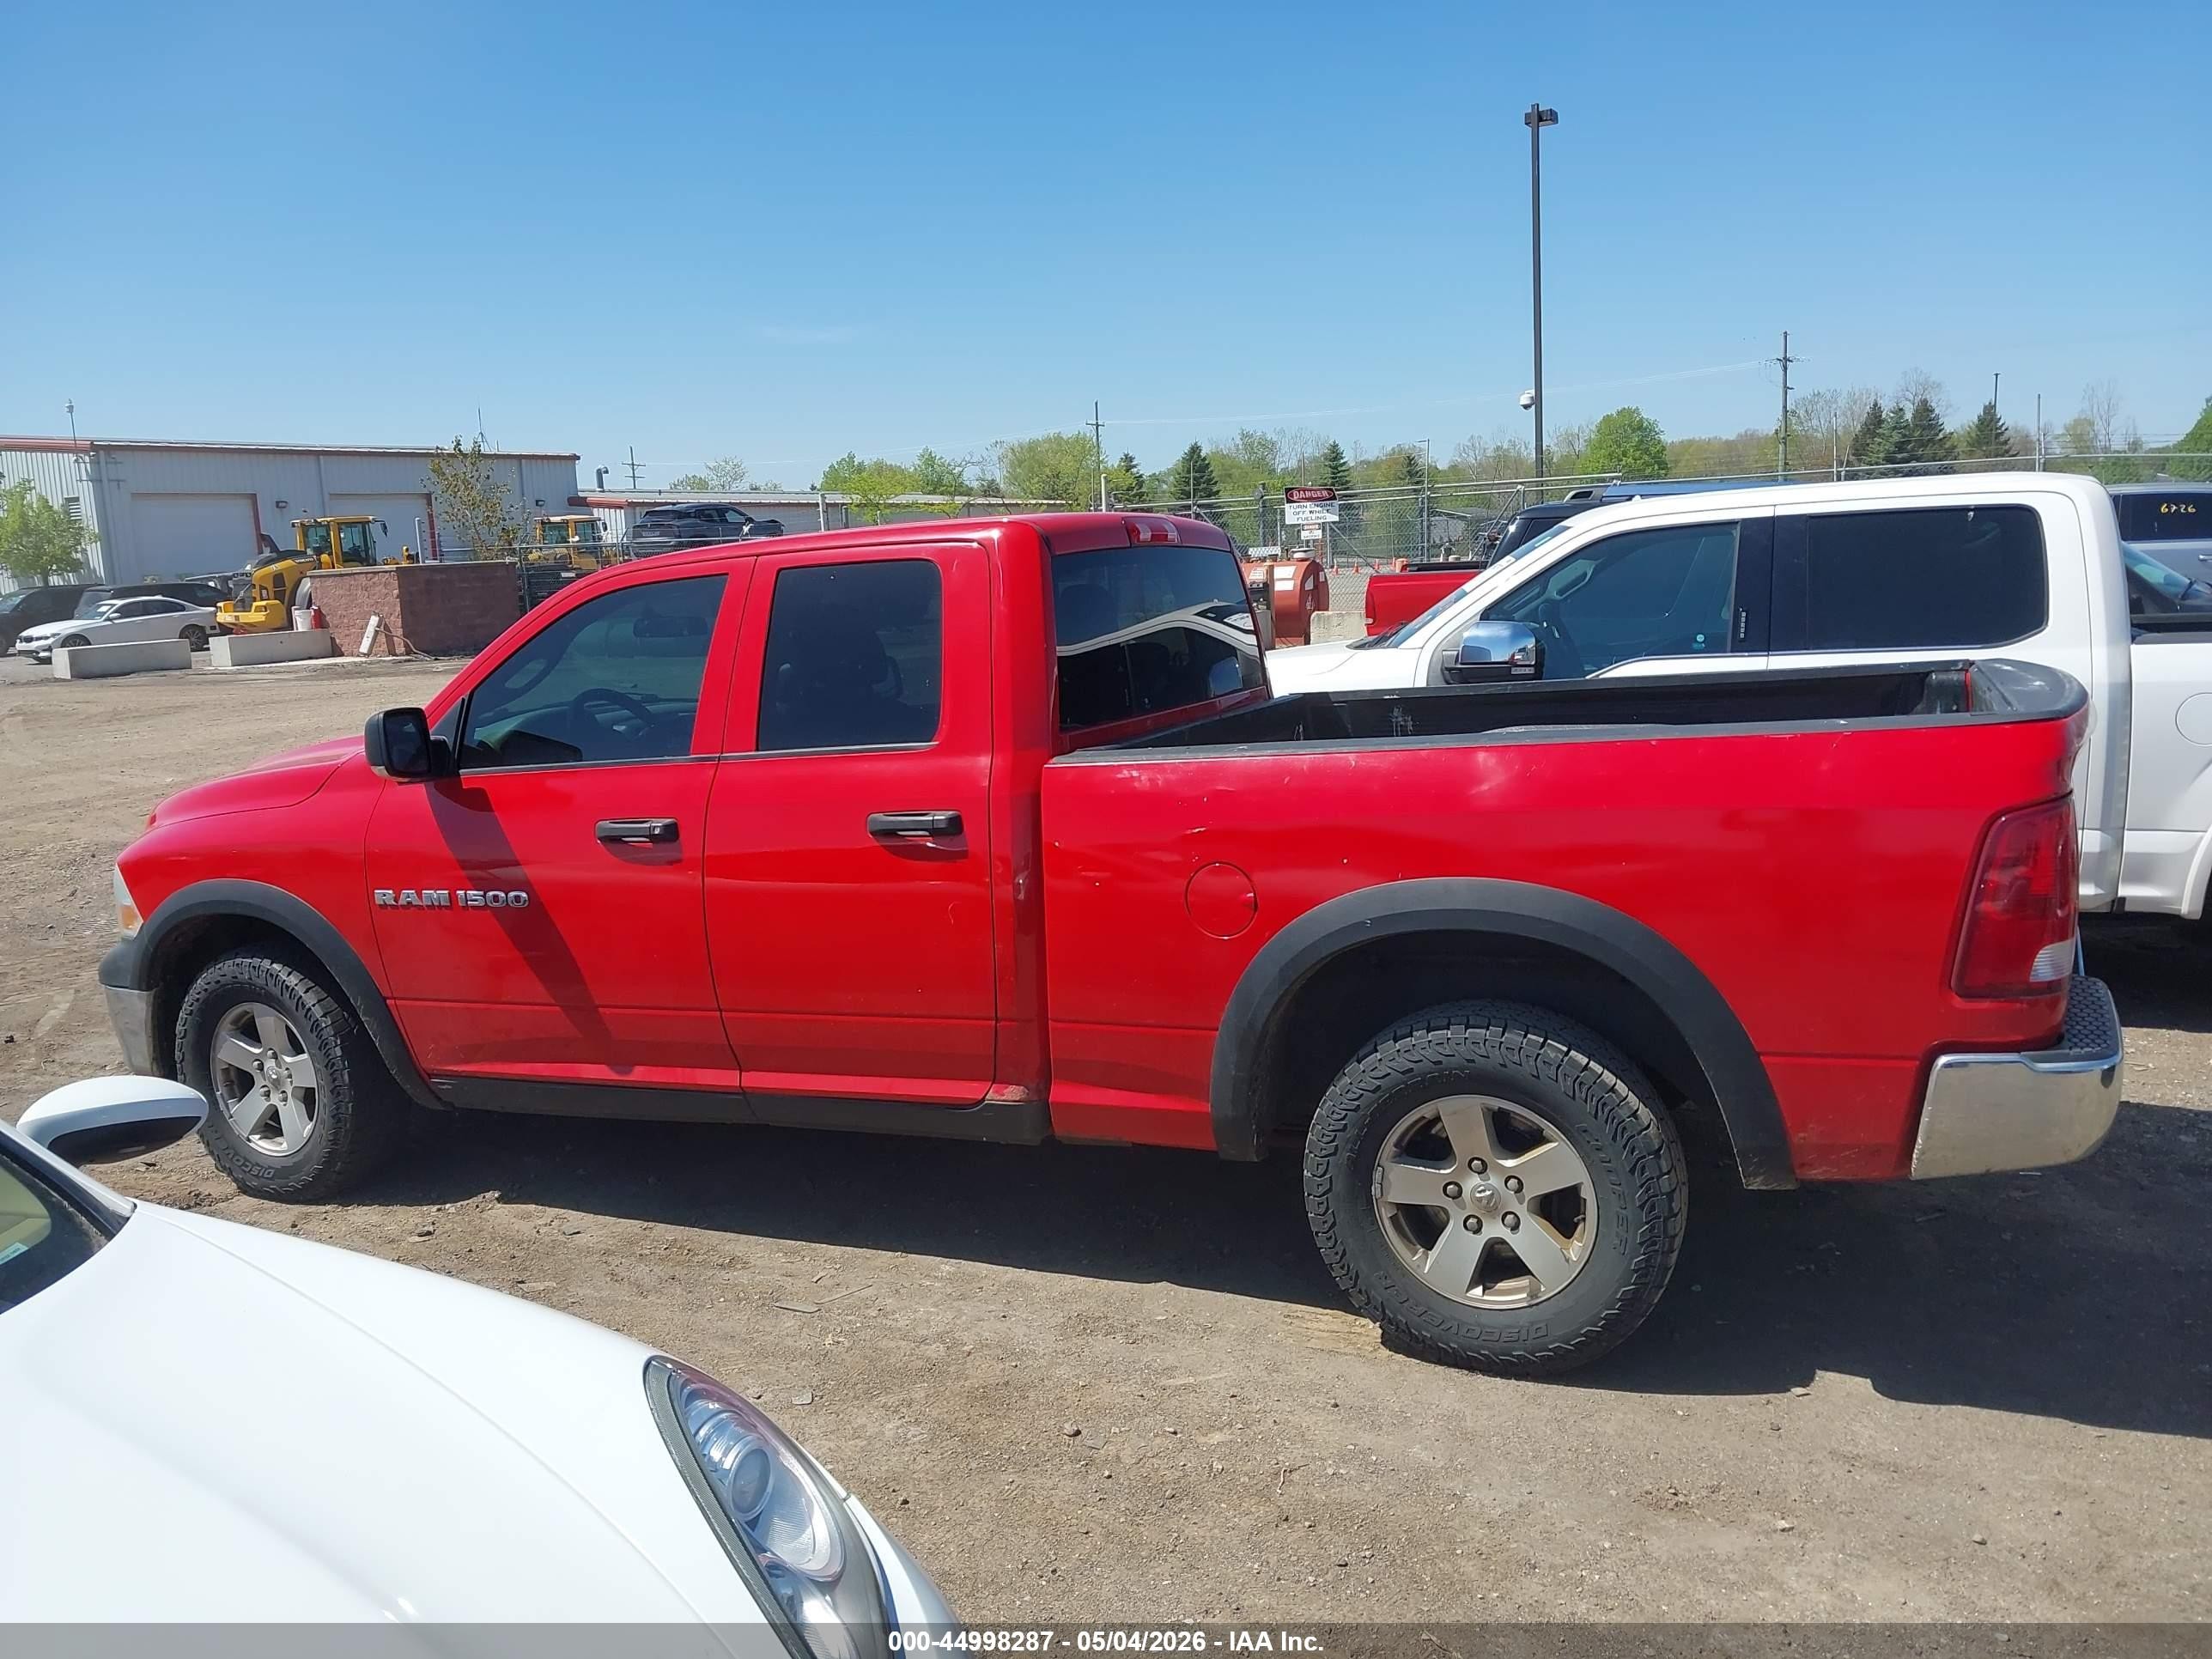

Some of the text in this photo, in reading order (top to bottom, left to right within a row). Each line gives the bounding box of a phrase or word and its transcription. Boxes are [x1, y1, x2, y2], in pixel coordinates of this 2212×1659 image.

[1293, 490, 1328, 500] DANGER
[2160, 503, 2197, 514] 6726
[374, 890, 530, 908] RAM 1500
[1575, 1123, 1629, 1255] COOPER
